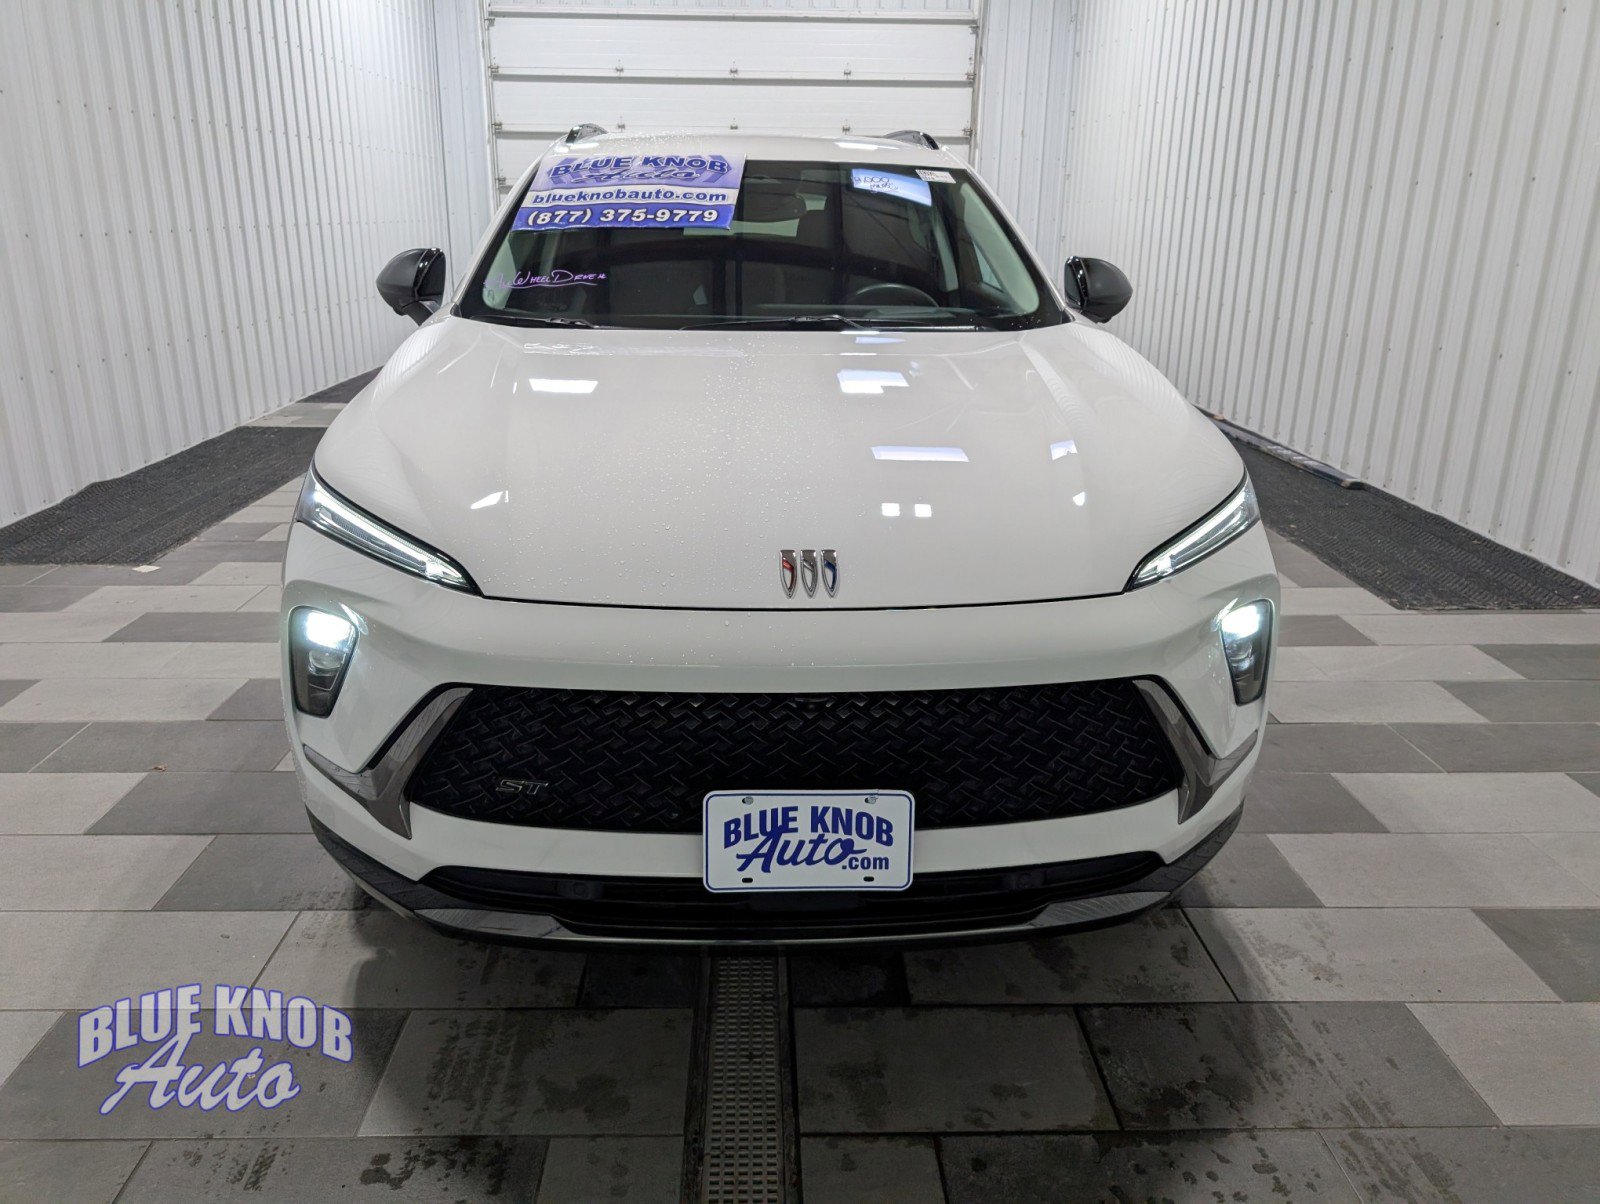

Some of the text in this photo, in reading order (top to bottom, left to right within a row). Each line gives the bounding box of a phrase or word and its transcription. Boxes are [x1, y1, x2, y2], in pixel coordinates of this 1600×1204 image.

[550, 156, 729, 177] BLUE KNOB
[571, 169, 700, 183] Auto
[532, 188, 727, 204] blueknobauto.com
[527, 208, 718, 226] (877) 375-9779
[495, 779, 549, 795] ST
[723, 805, 894, 849] BLUE KNOB
[735, 824, 868, 873] Auto
